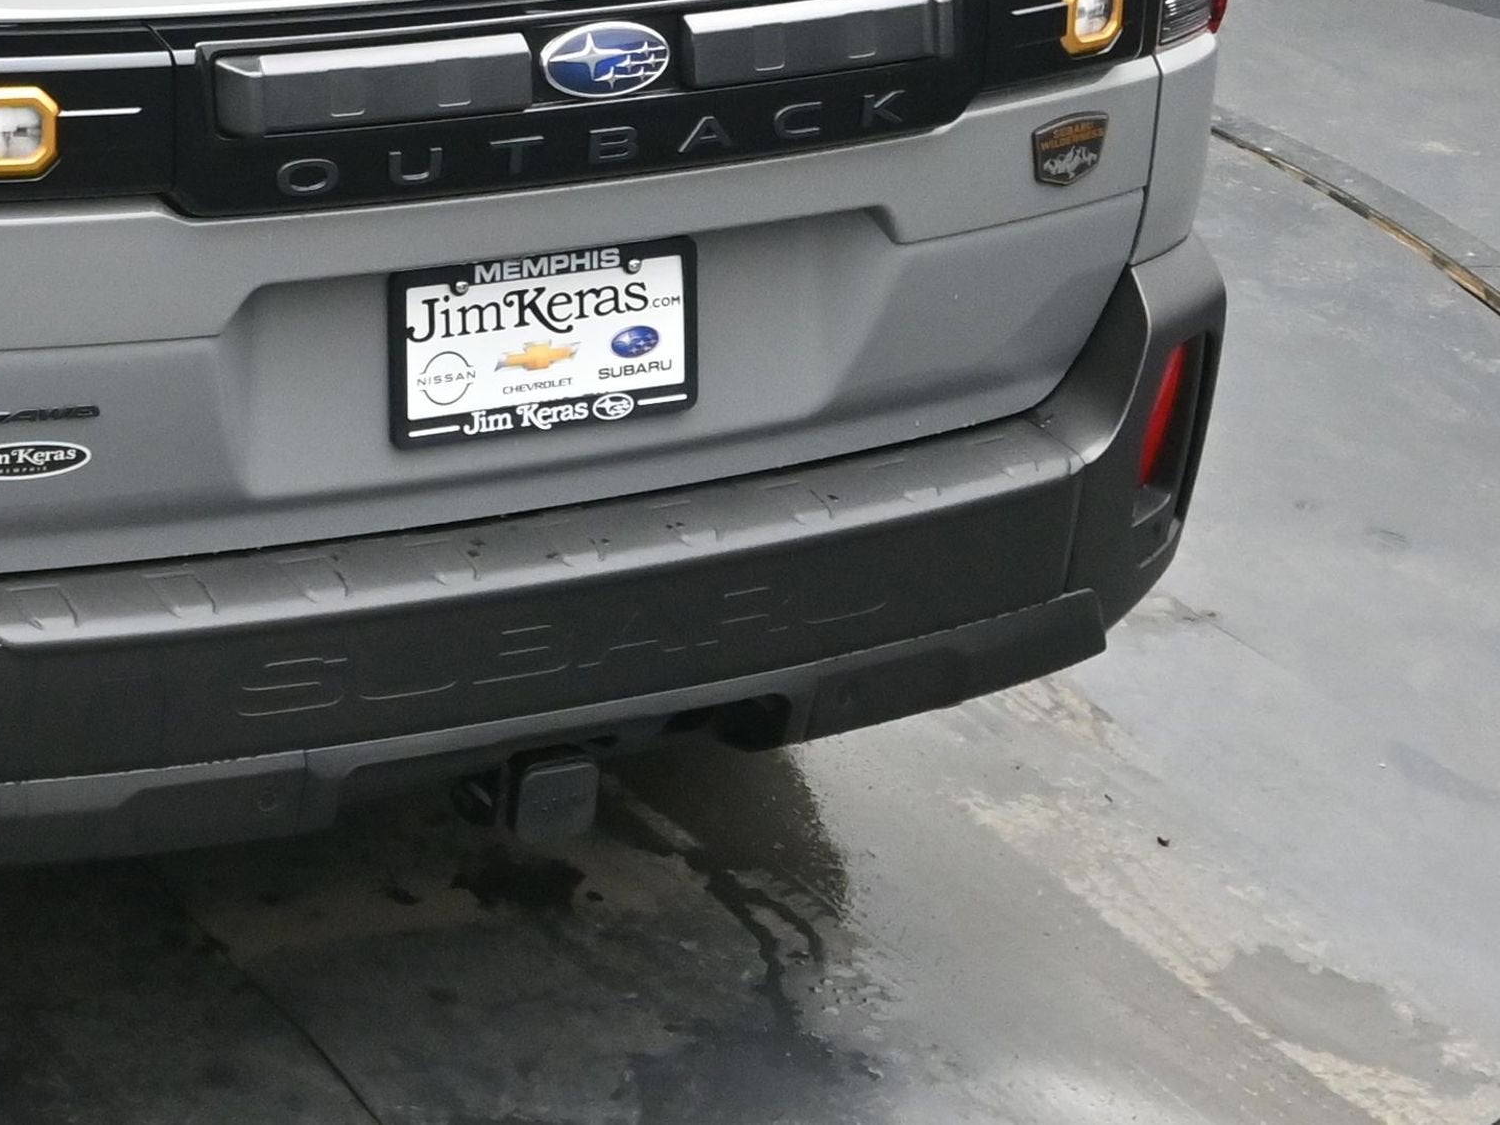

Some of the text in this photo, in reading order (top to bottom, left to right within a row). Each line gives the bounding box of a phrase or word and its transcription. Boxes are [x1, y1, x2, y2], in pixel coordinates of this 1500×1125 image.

[277, 88, 906, 196] OUTBACK
[474, 247, 621, 284] MEMPHIS
[416, 369, 476, 388] NISSAN
[598, 359, 673, 381] SUBARU
[502, 377, 573, 395] CHEVROLET
[463, 401, 589, 436] Jim Keras
